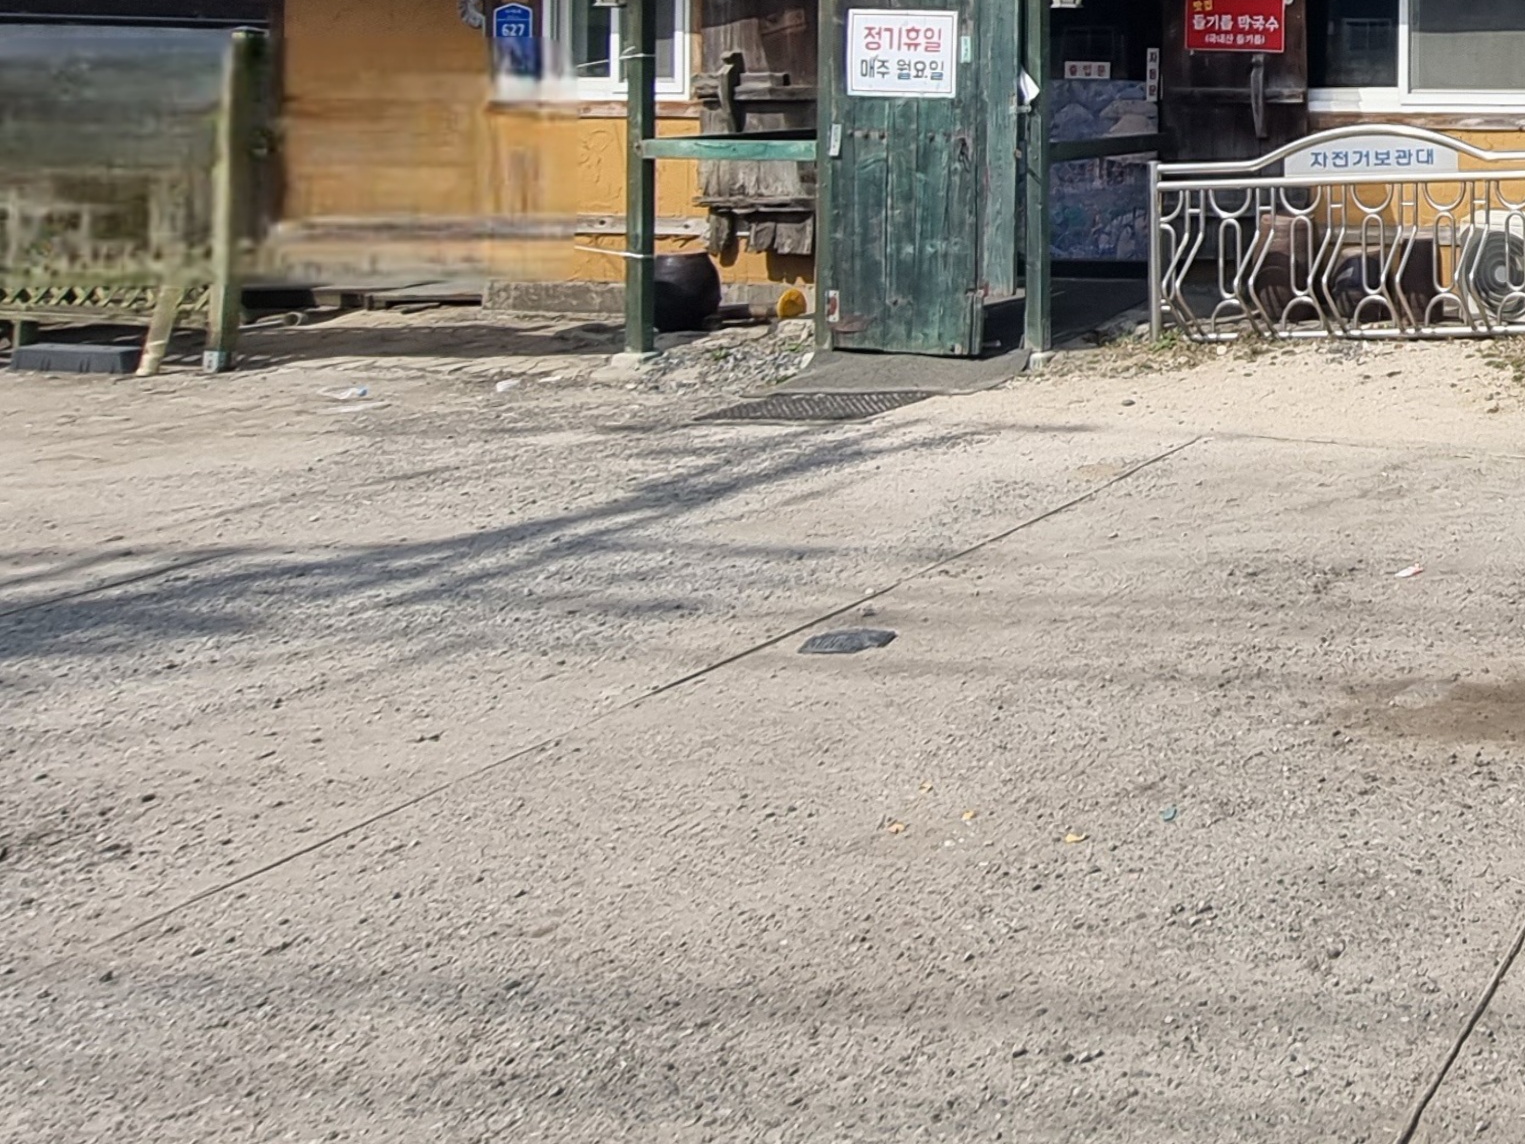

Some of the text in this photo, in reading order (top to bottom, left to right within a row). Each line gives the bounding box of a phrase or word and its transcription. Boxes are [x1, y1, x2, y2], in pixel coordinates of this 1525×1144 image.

[501, 23, 526, 37] 627
[1237, 14, 1280, 33] 막국수
[863, 26, 942, 53] 정기휴일
[860, 58, 945, 81] 매주 월요일
[1310, 147, 1435, 169] 자전거보관대
